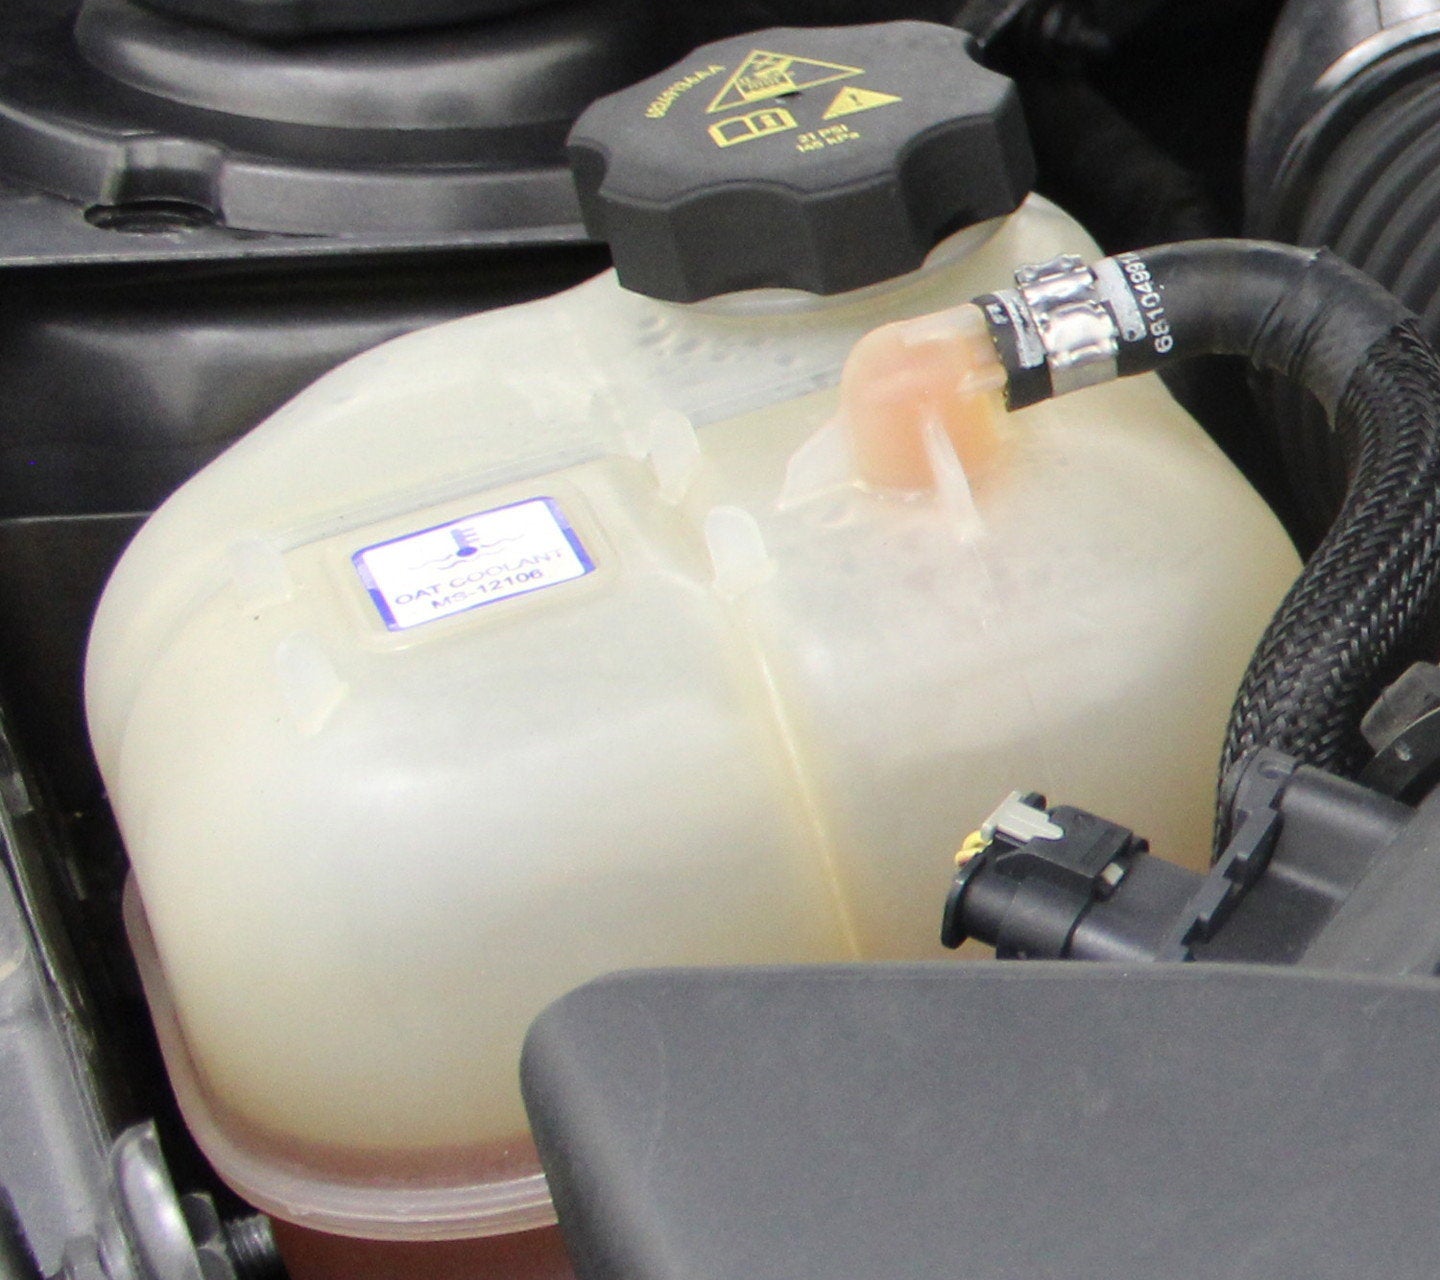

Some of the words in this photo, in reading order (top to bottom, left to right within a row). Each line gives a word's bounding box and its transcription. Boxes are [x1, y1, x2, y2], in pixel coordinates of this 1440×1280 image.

[394, 583, 442, 606] OAT
[449, 549, 565, 589] COOLANT
[431, 568, 544, 610] MS-12106
